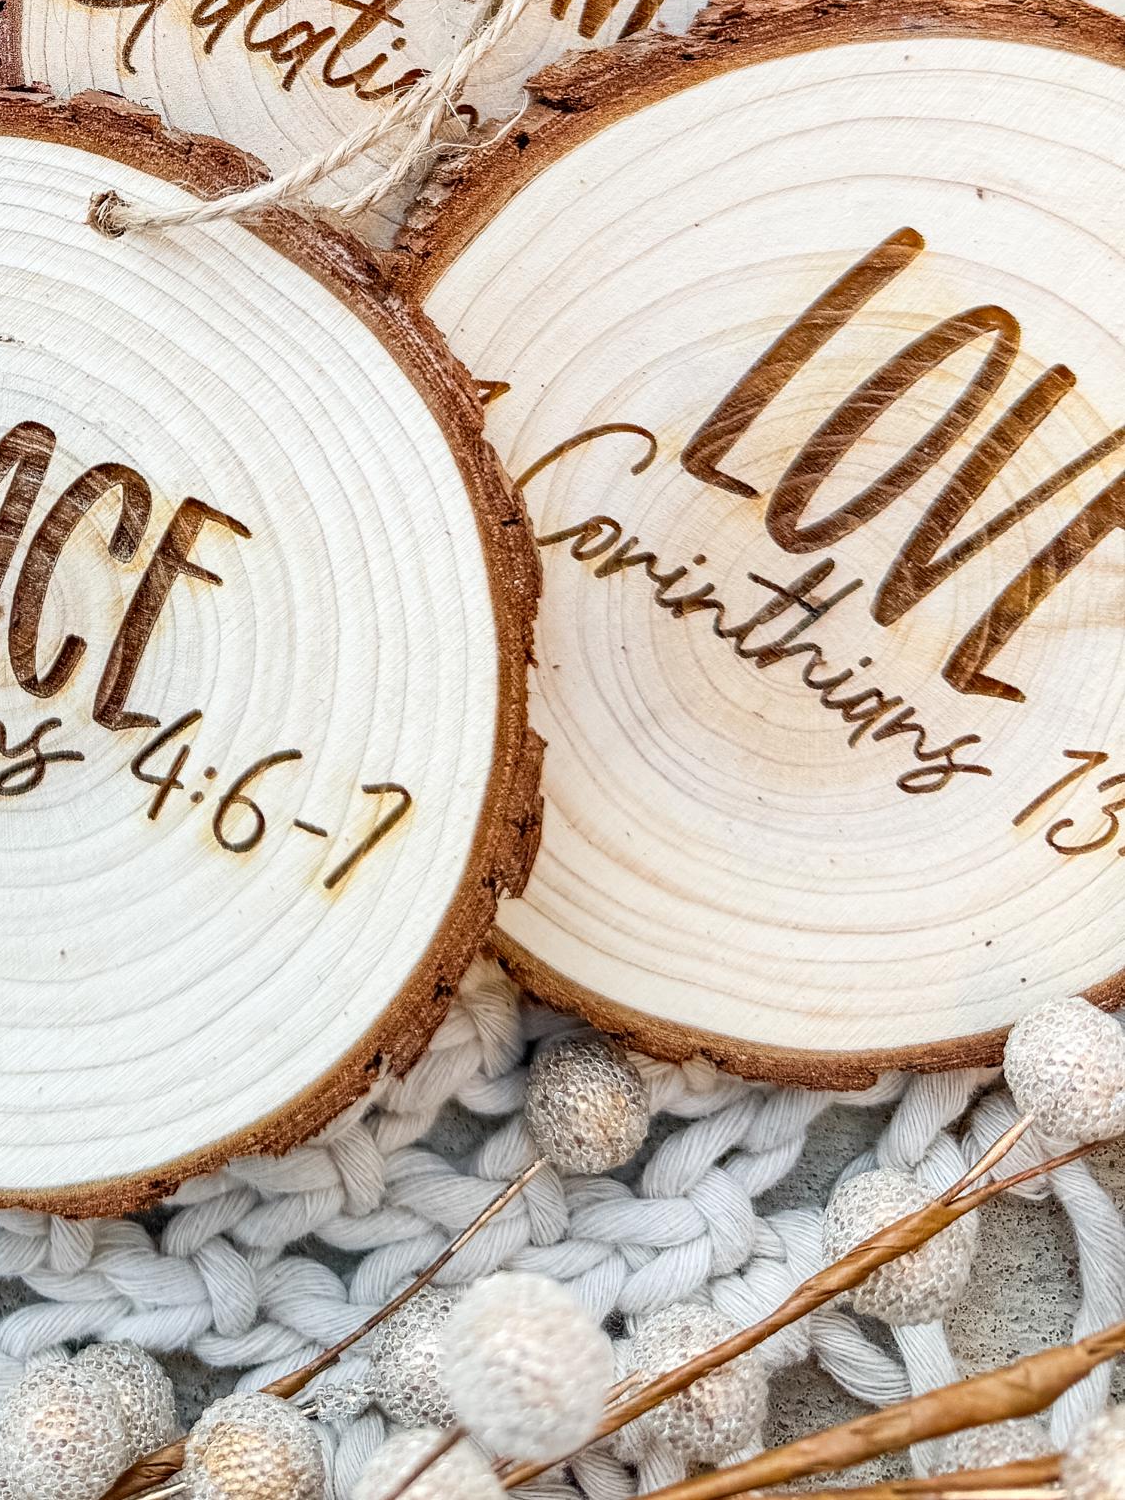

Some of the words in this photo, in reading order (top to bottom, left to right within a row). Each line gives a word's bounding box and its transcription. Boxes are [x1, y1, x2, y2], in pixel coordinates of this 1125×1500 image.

[510, 422, 993, 794] Corinthians
[1012, 749, 1125, 856] 13
[130, 709, 413, 890] 4:6-7
